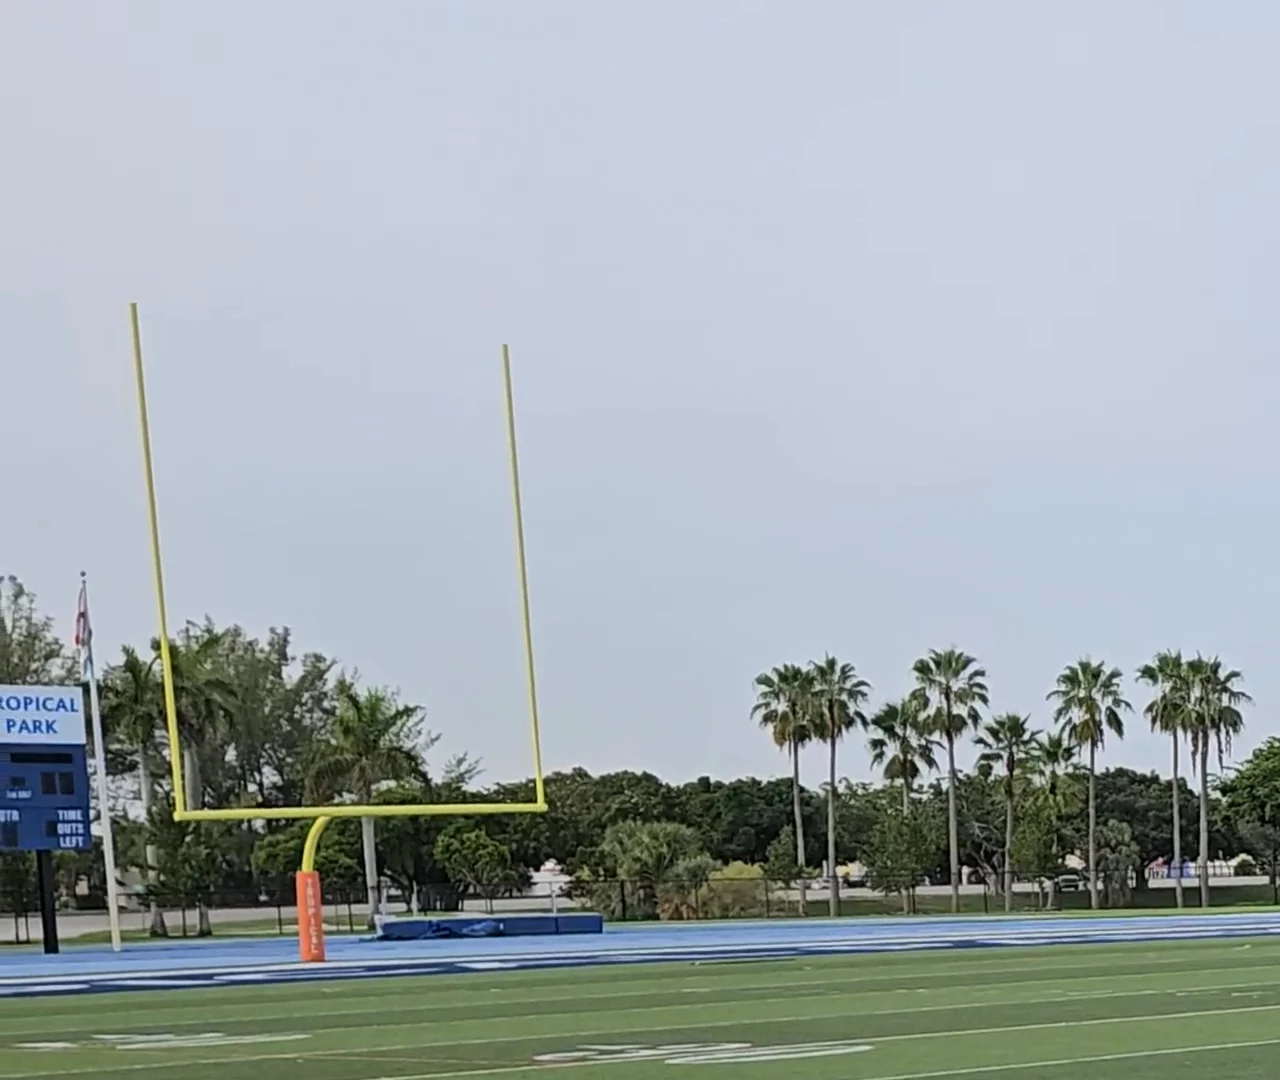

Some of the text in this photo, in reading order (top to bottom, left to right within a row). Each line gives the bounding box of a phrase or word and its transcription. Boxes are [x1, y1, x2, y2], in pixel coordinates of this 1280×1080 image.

[6, 718, 58, 734] PARK
[57, 809, 83, 821] TIME
[57, 822, 84, 835] OUTS
[60, 836, 84, 848] LEFT
